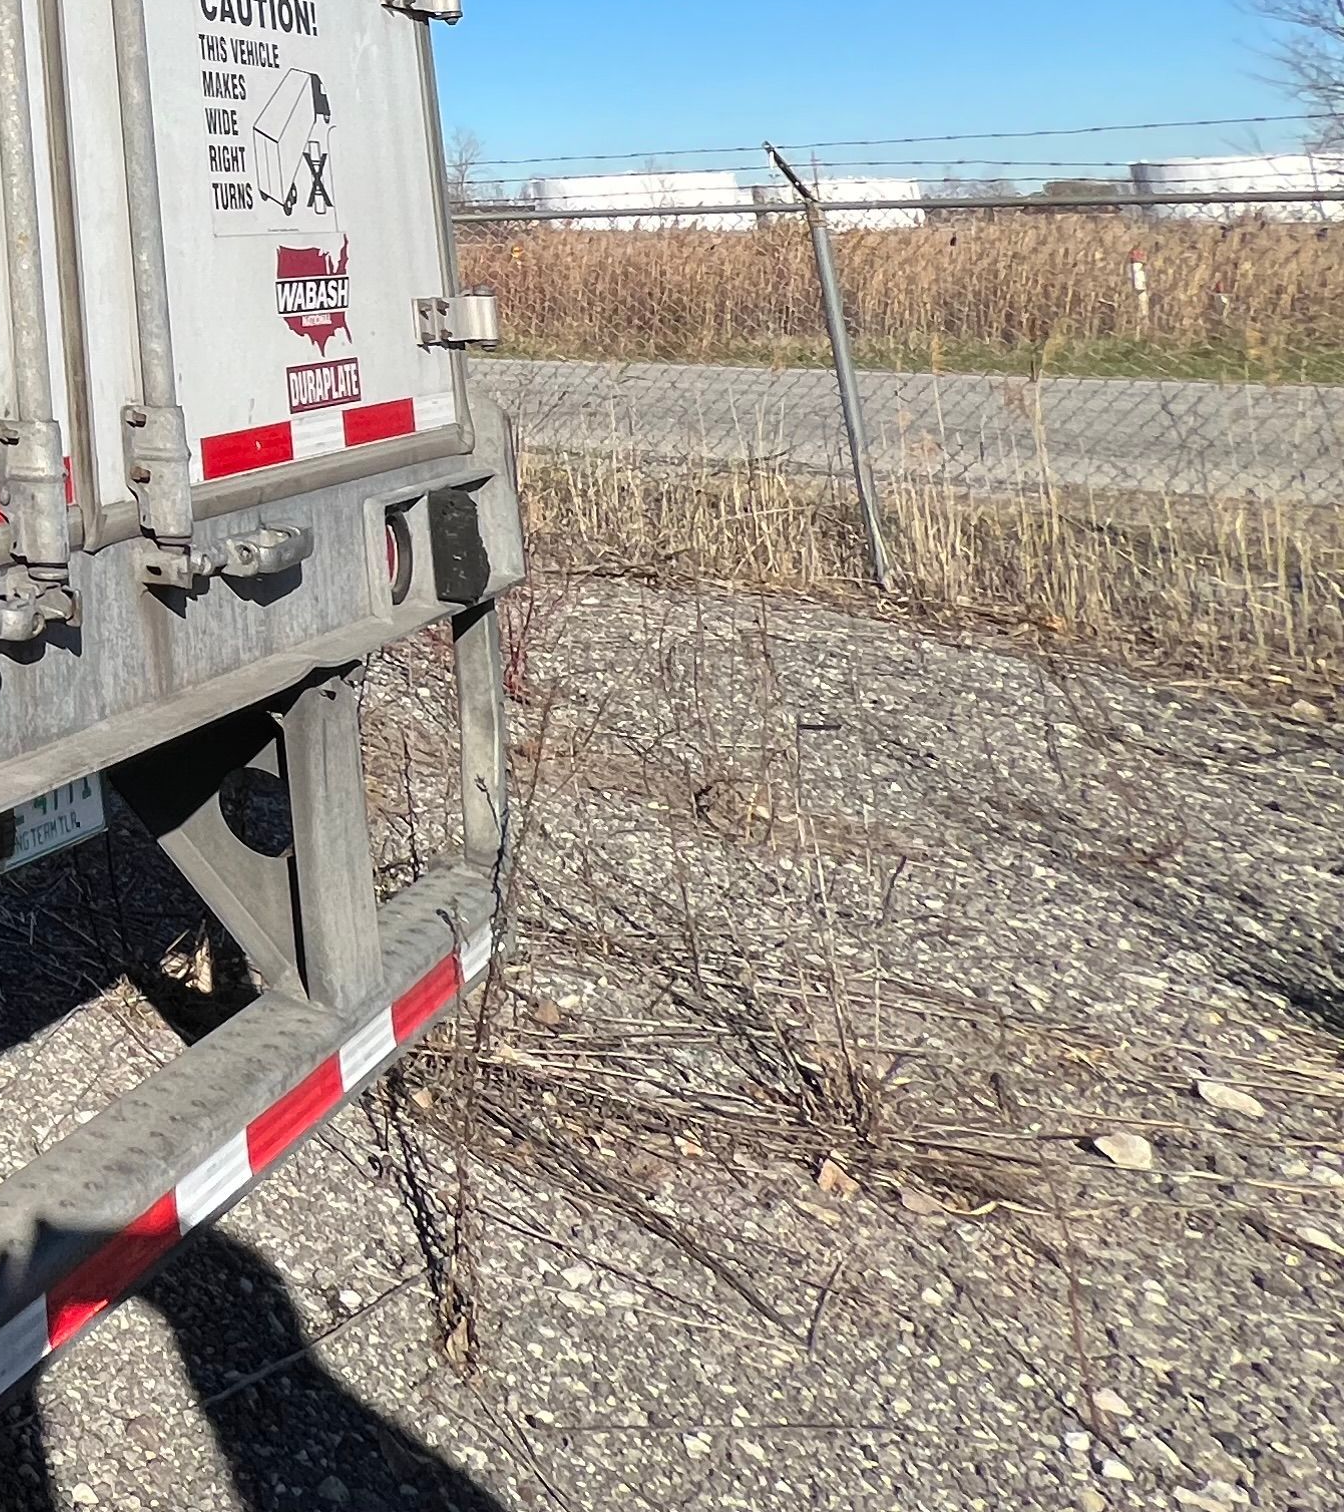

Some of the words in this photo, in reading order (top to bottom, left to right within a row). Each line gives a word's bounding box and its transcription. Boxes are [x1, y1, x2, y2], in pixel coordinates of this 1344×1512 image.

[199, 34, 227, 63] THIS
[230, 38, 280, 69] VEHICLE
[202, 70, 247, 100] MAKES
[205, 107, 239, 136] WIDE
[209, 145, 246, 173] RIGHT
[212, 182, 254, 210] TURNS
[277, 279, 349, 313] WABASH
[289, 362, 359, 408] DURAPLATE
[15, 831, 30, 853] NG
[30, 819, 57, 847] TERM
